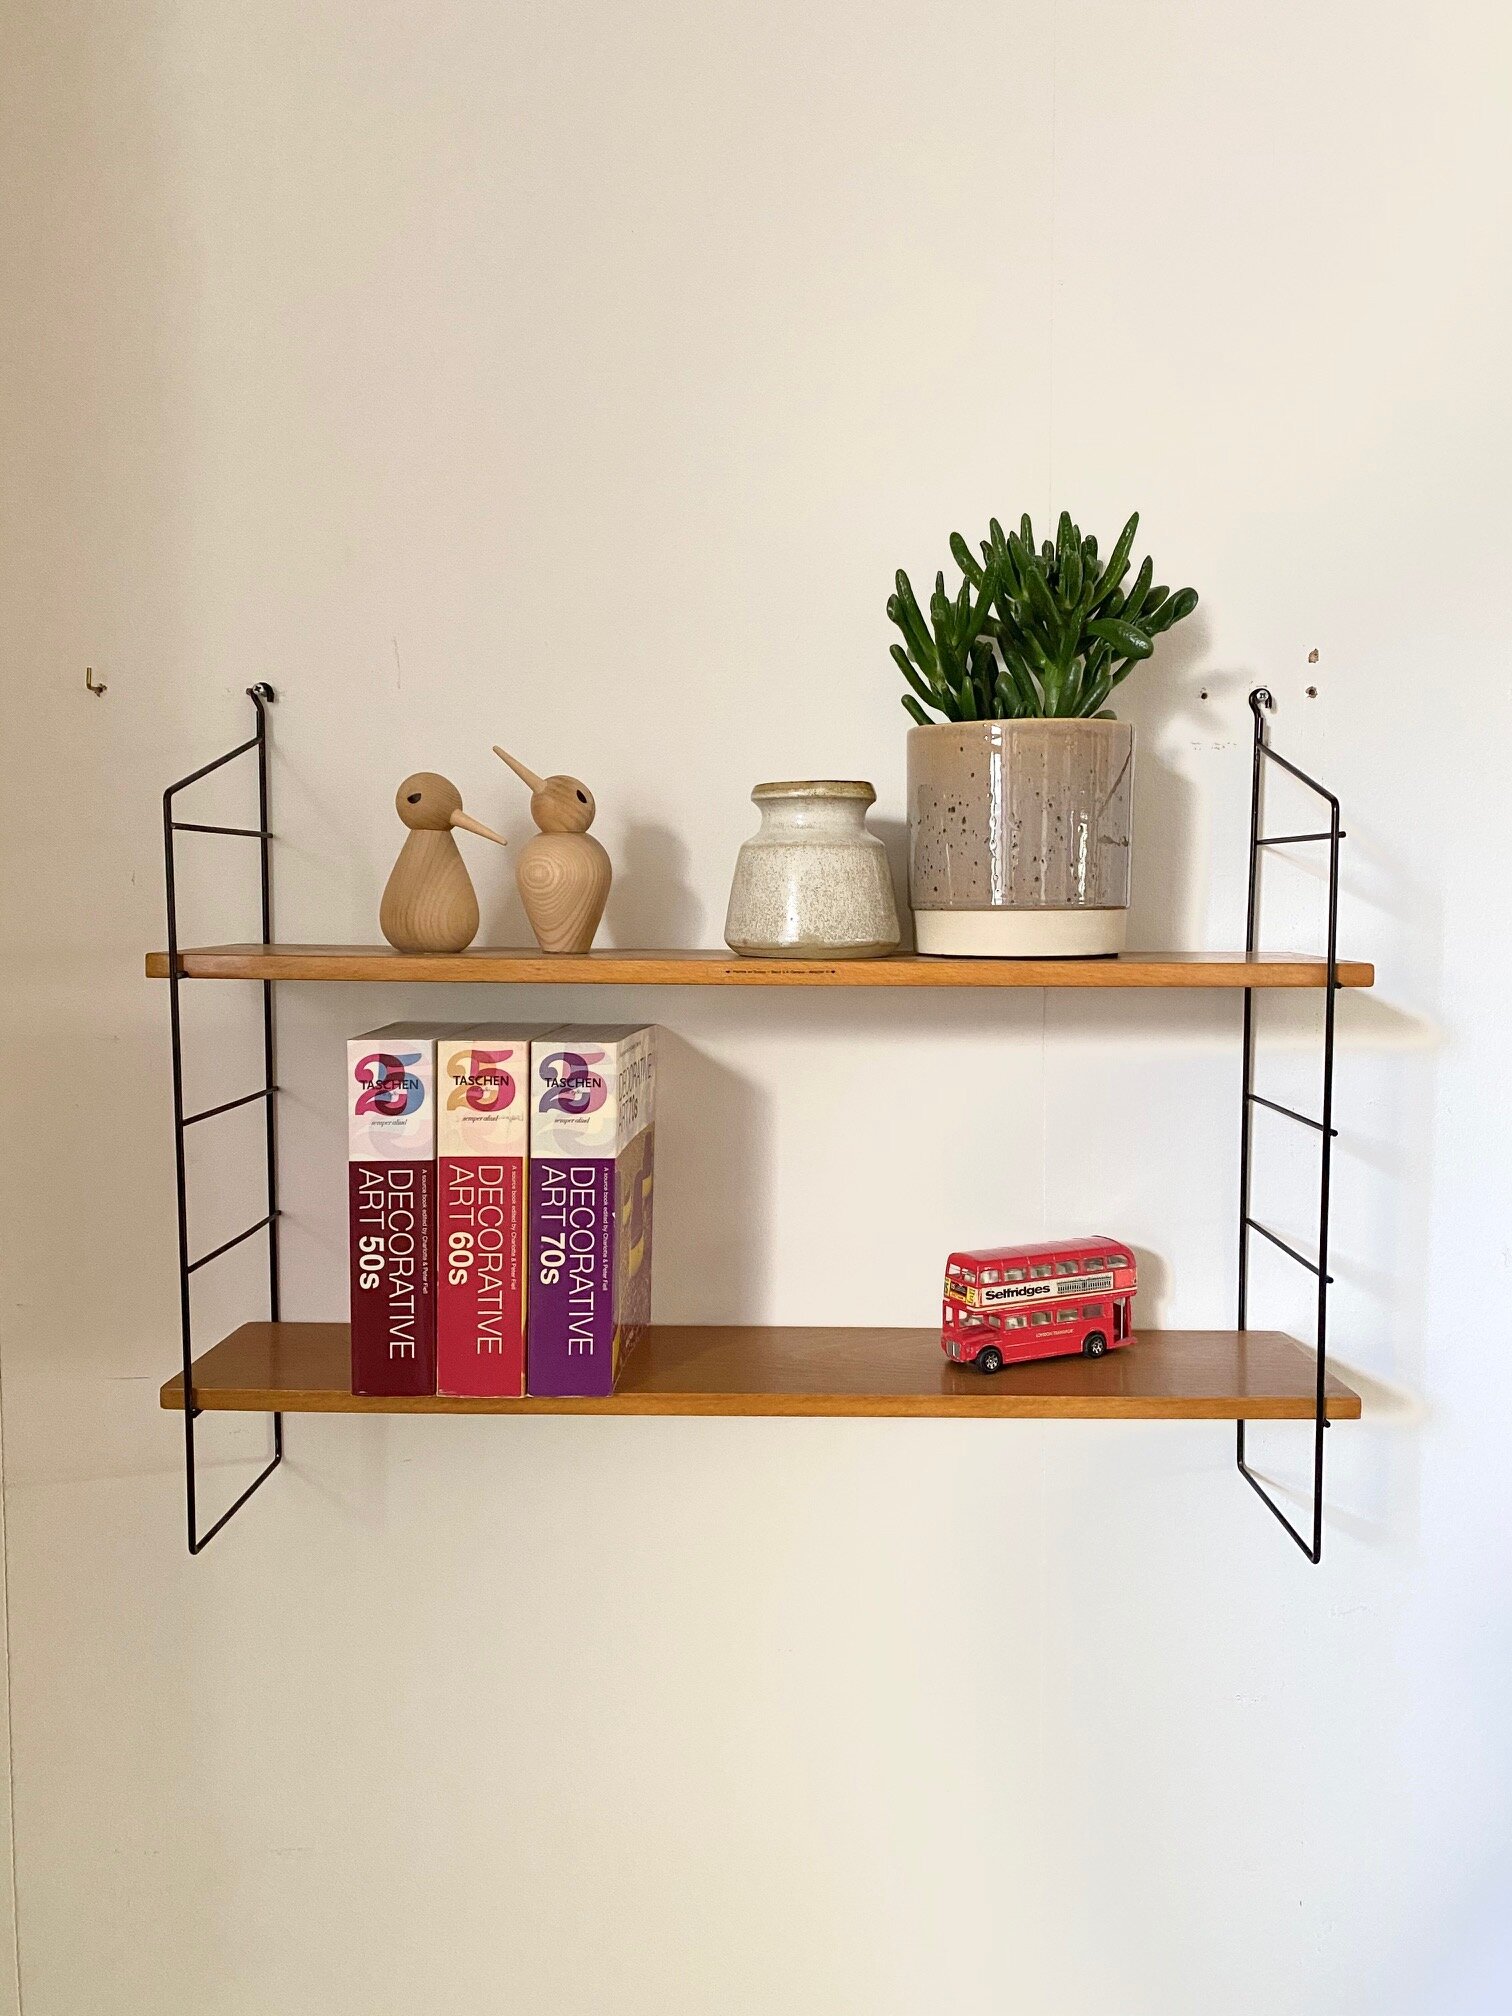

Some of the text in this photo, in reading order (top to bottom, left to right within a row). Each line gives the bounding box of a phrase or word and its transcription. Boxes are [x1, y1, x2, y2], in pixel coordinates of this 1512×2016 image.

[360, 1080, 418, 1090] TASCHEN
[453, 1076, 509, 1086] TASCHEN
[545, 1078, 601, 1088] TASCHEN
[359, 1169, 384, 1289] ART 50s
[388, 1170, 415, 1359] DECORATIVE
[421, 1227, 428, 1235] by
[449, 1165, 474, 1285] ART 60s
[478, 1166, 503, 1354] DECORATIVE
[540, 1166, 566, 1285] ART 70s
[569, 1167, 595, 1356] DECORATIVE
[986, 1285, 1050, 1300] Selfridges
